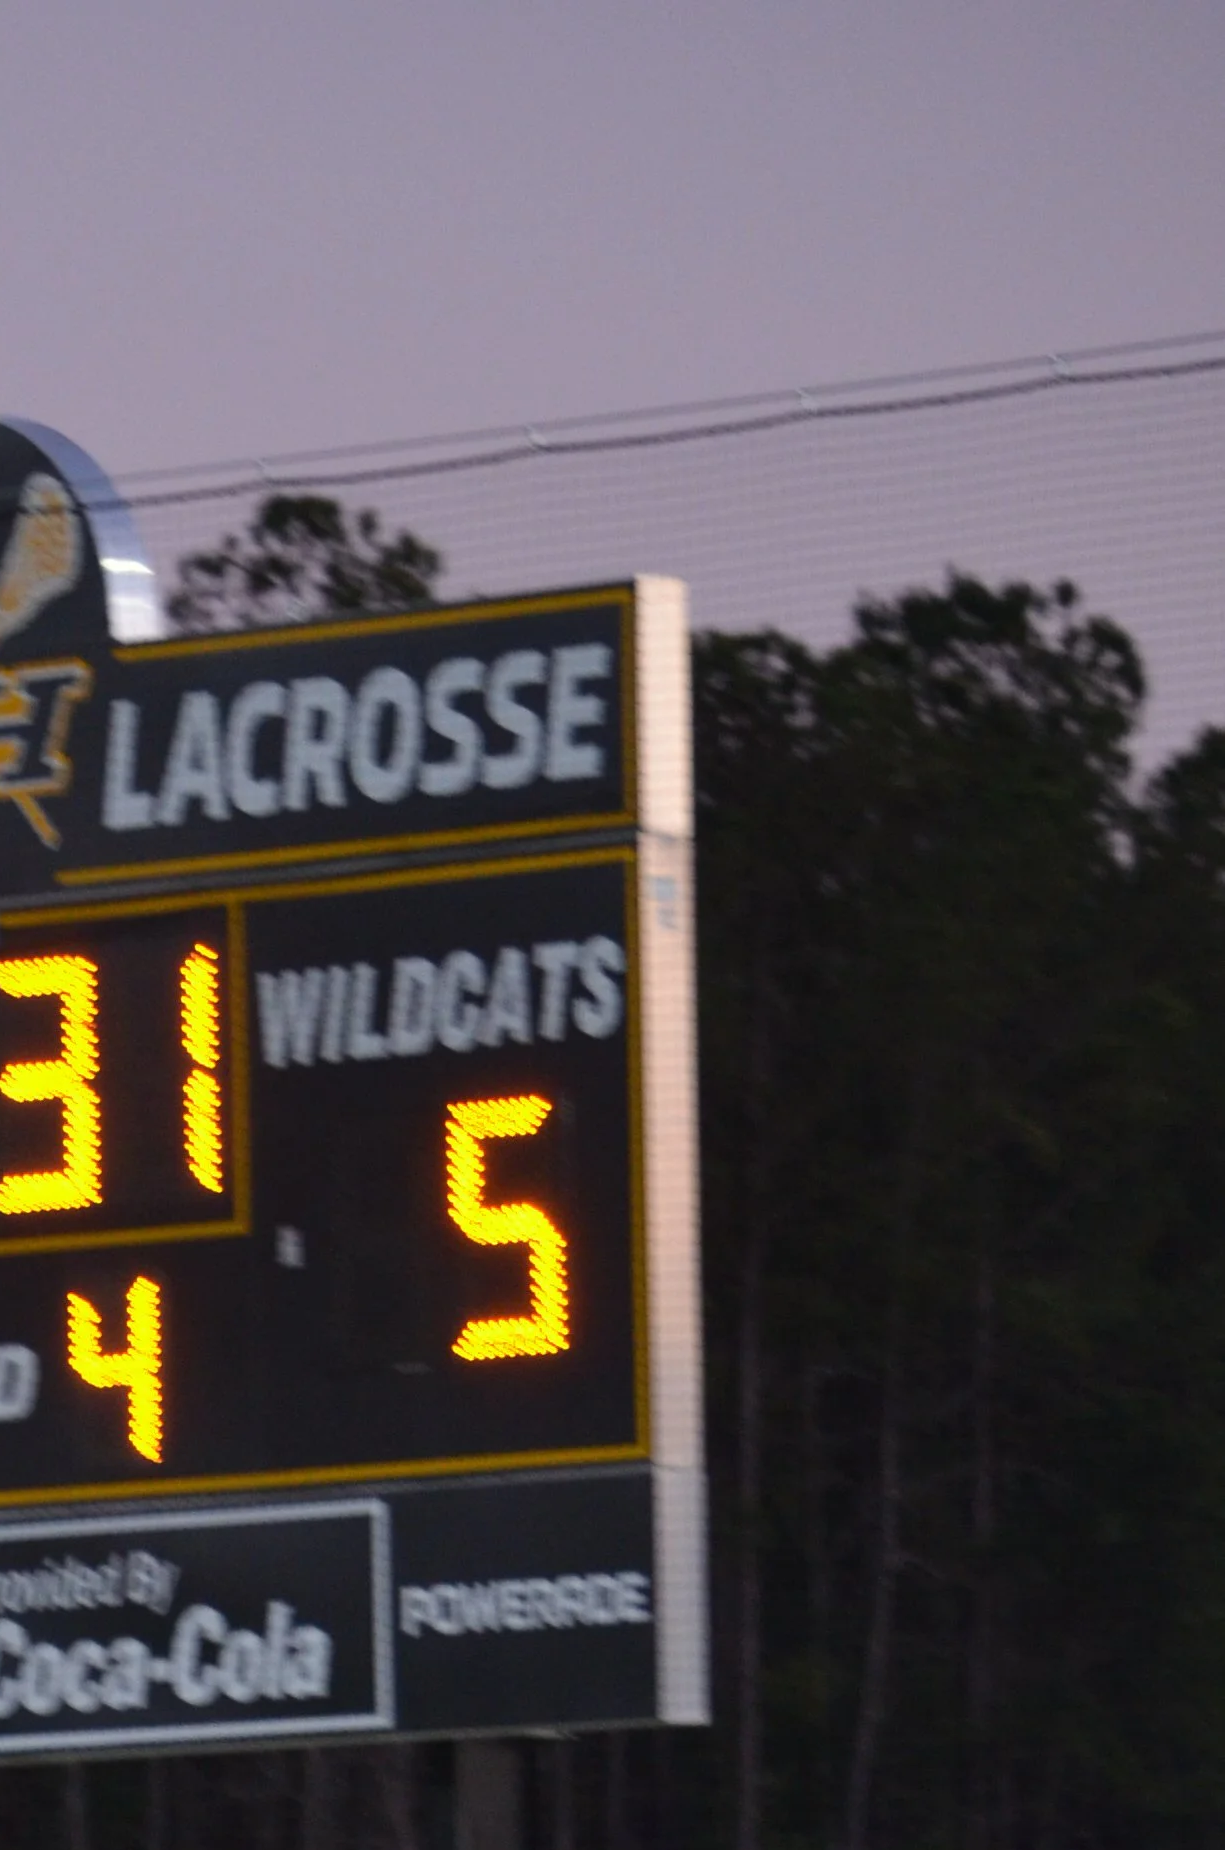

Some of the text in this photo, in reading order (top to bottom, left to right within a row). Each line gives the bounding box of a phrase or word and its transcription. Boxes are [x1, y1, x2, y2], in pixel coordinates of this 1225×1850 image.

[101, 641, 612, 831] LACROSSE
[255, 935, 626, 1068] WILDCATS
[445, 1094, 569, 1361] 5
[67, 1275, 163, 1464] 4
[399, 1571, 652, 1639] POWERADE
